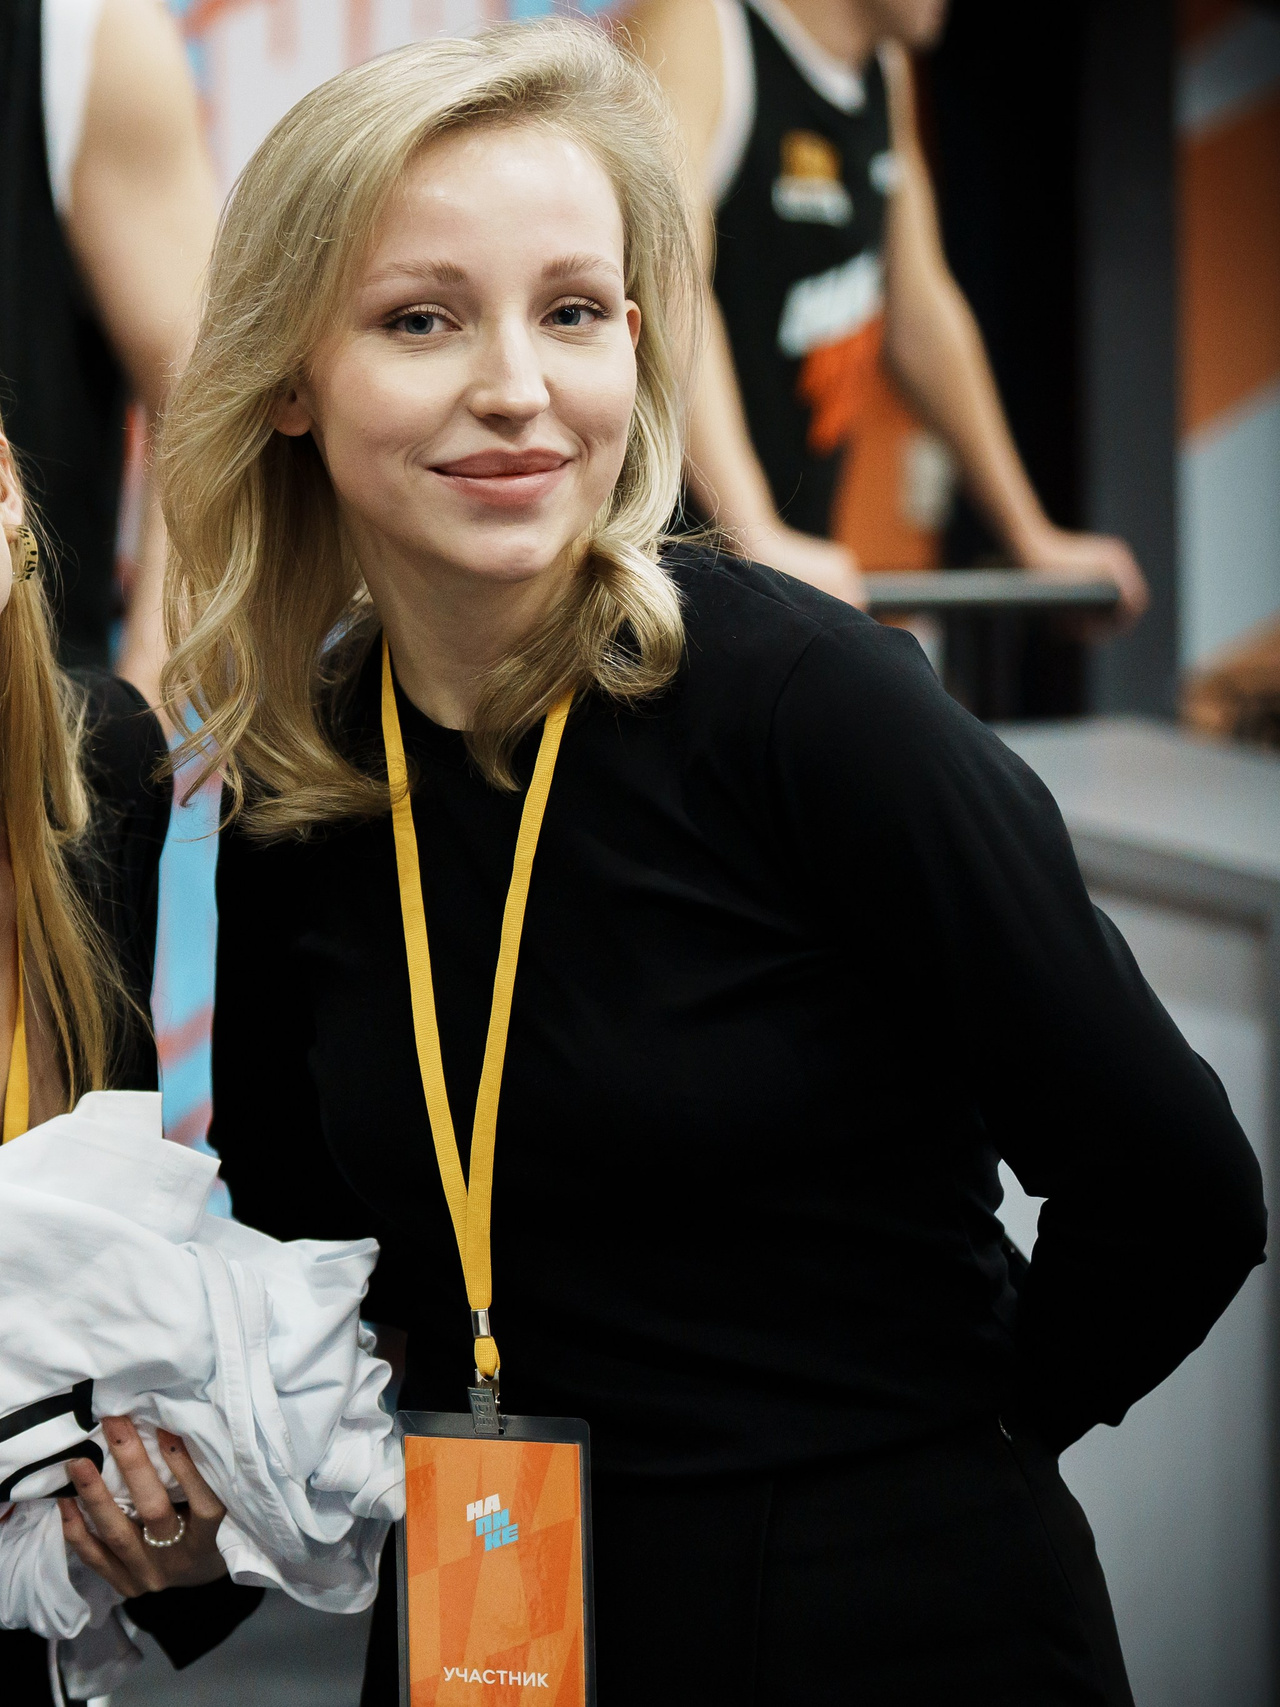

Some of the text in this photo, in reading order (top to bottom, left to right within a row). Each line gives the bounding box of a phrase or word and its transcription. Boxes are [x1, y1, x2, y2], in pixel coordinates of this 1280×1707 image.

[466, 1493, 501, 1522] НА
[475, 1508, 510, 1537] ПИ
[484, 1523, 519, 1552] КЕ
[443, 1666, 549, 1688] УЧАСТНИК
